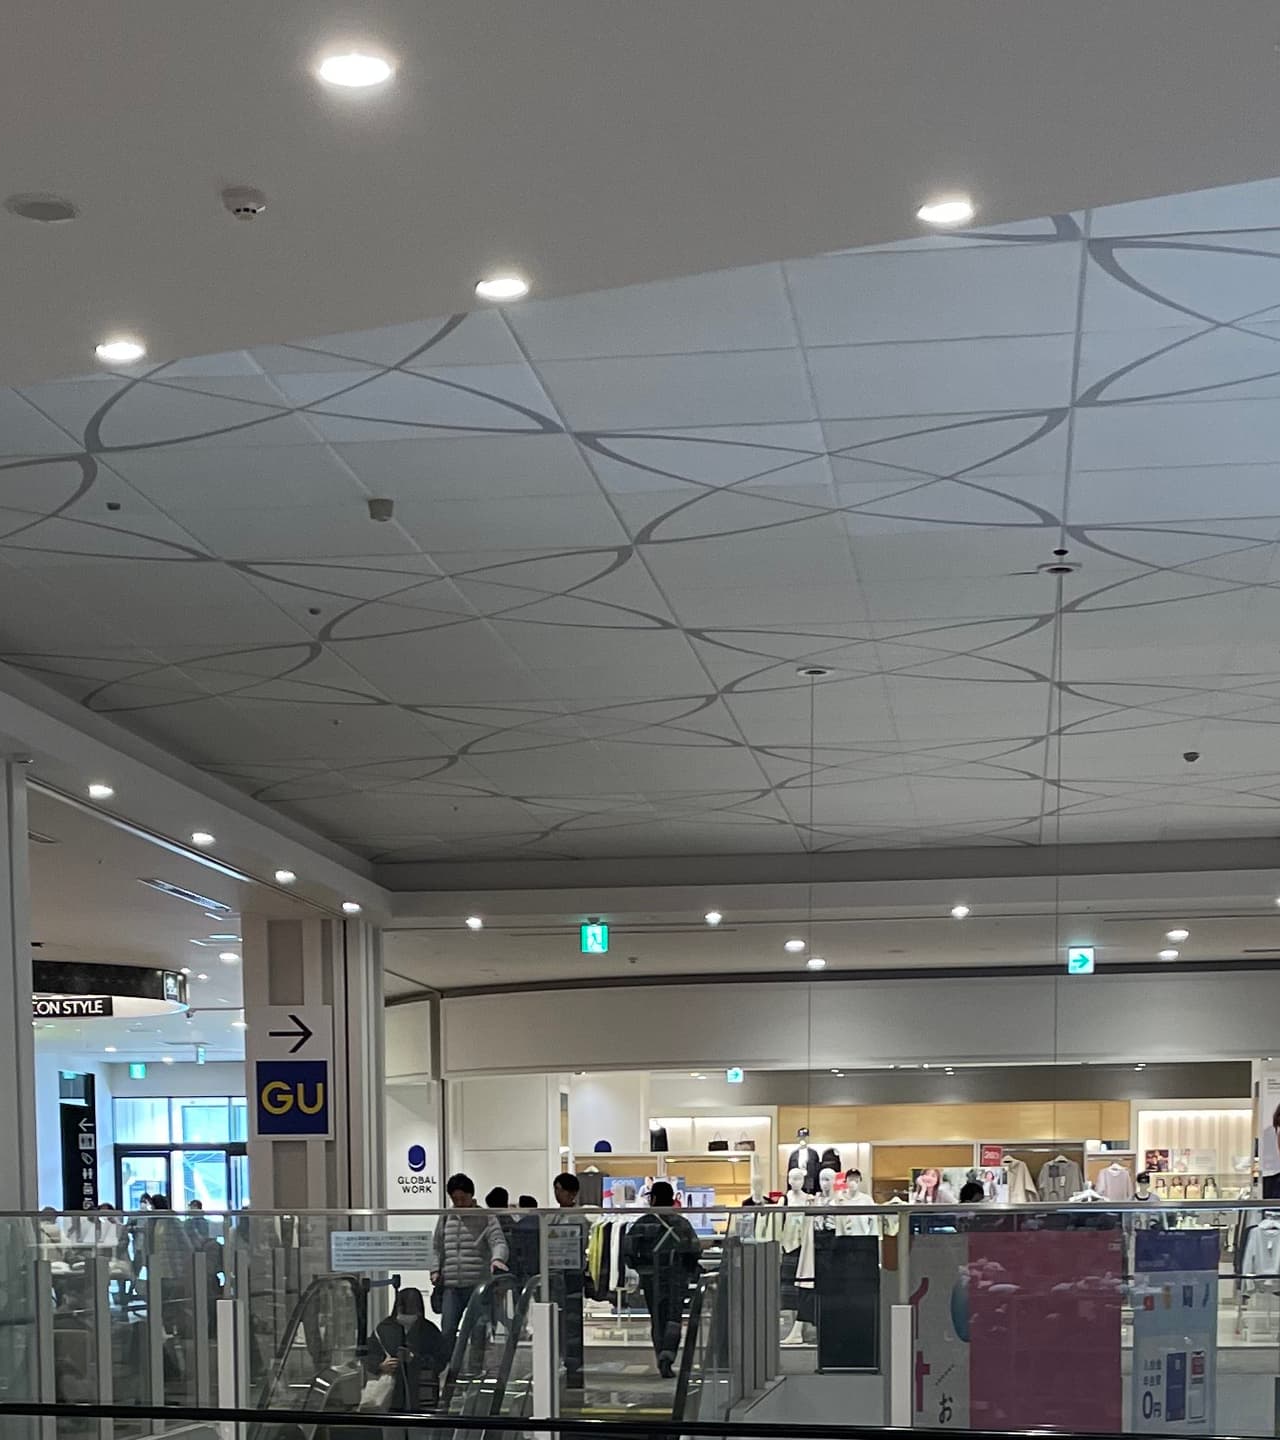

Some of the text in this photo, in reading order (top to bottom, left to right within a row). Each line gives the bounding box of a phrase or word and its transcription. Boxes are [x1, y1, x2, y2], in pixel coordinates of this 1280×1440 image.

[63, 999, 104, 1014] STYLE
[261, 1081, 324, 1115] GU
[397, 1176, 437, 1185] GLOBAL
[402, 1185, 432, 1194] WORK
[1143, 1391, 1161, 1419] 0円
